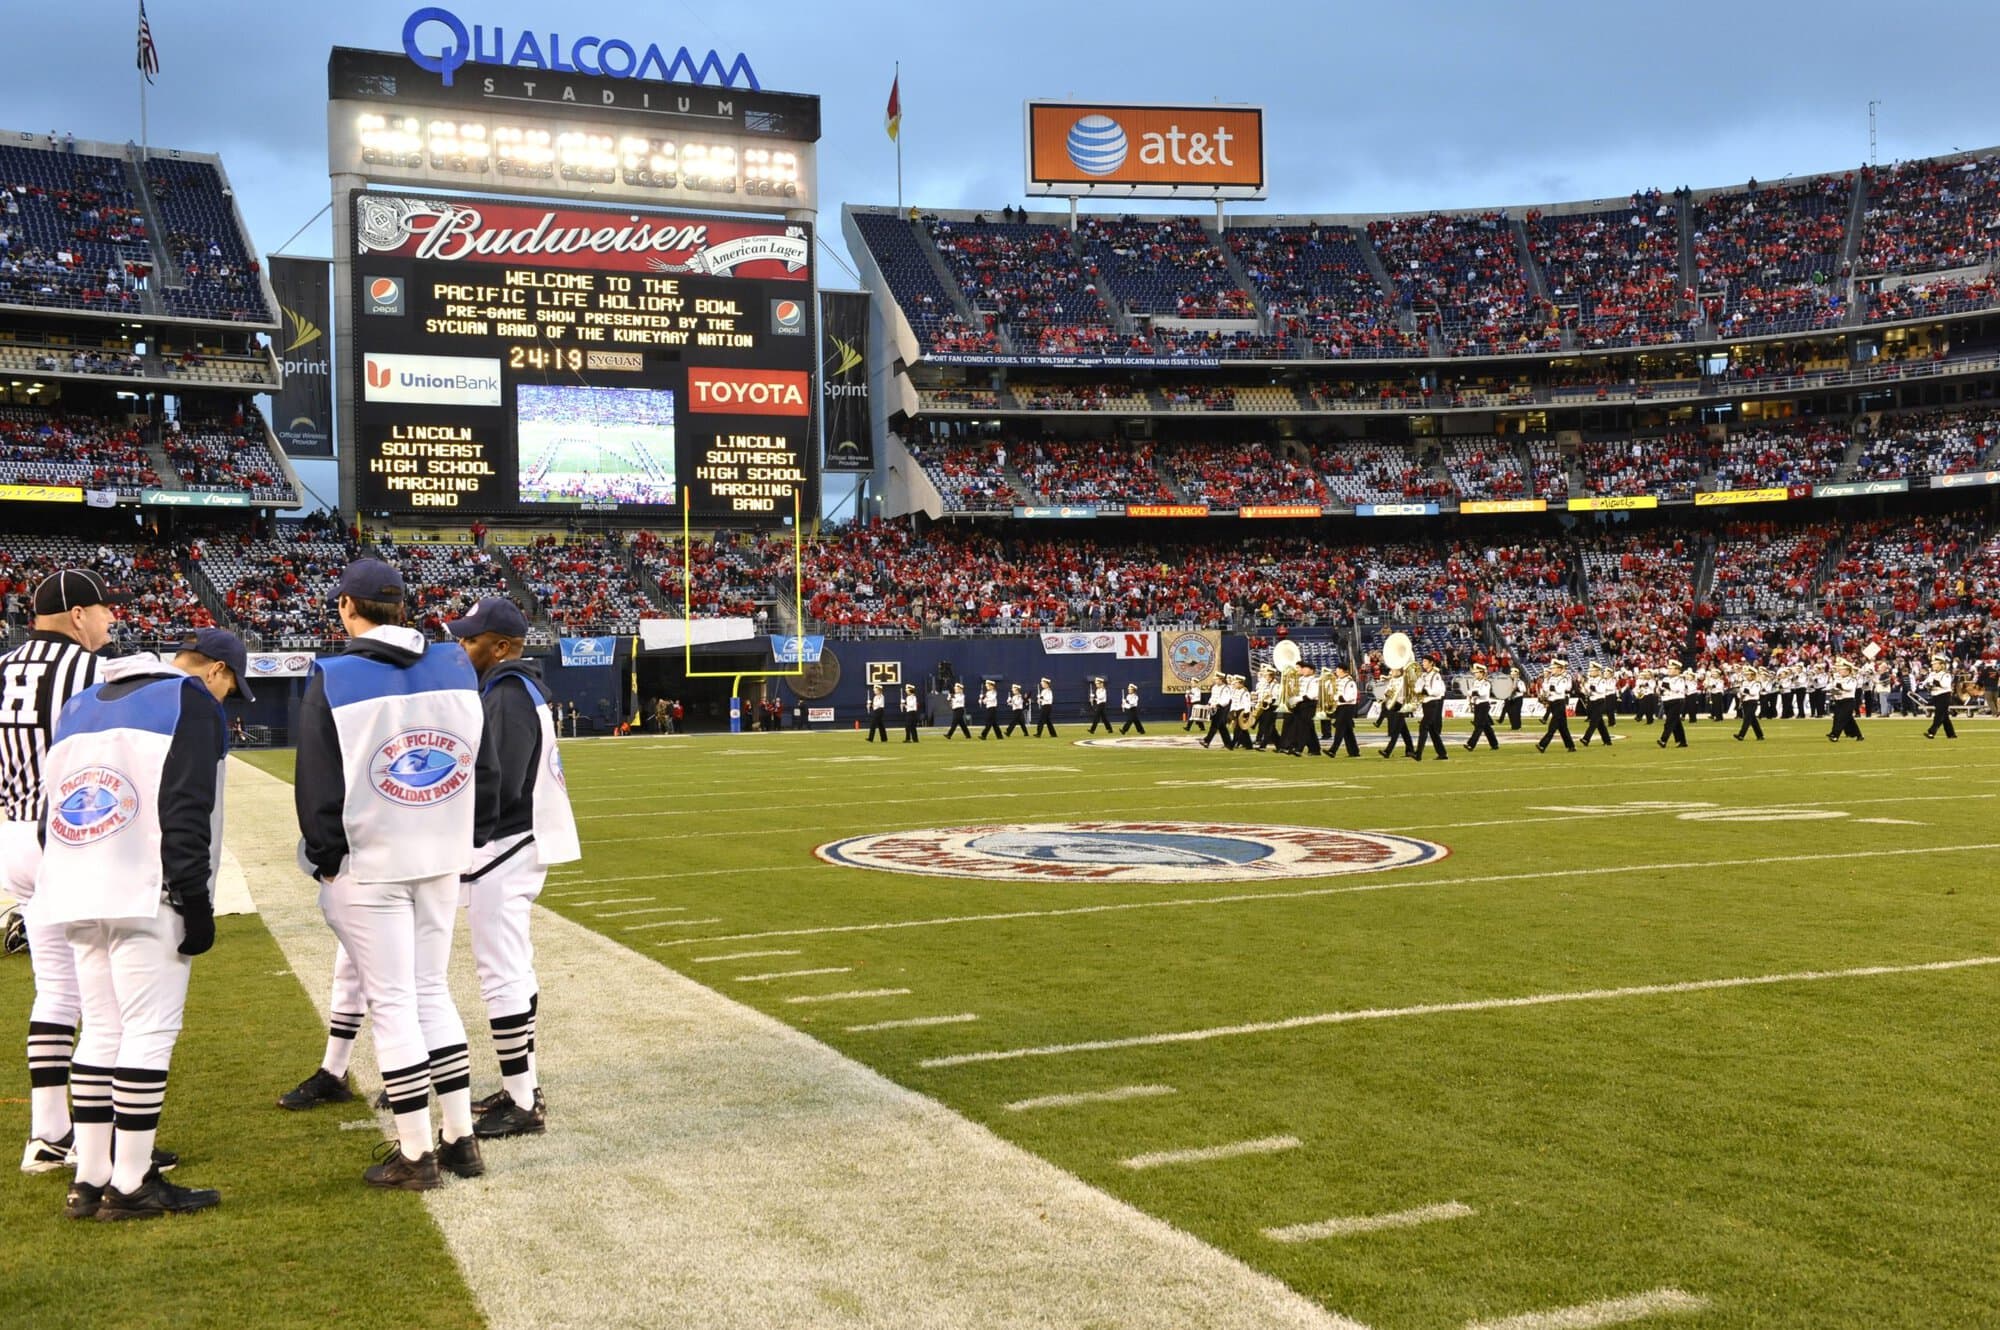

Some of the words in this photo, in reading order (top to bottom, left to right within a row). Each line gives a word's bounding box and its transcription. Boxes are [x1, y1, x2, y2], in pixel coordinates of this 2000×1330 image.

[402, 7, 760, 91] QUALCOMM
[484, 78, 733, 116] STADIUM
[1140, 125, 1233, 166] at&t
[402, 208, 707, 261] Budweiser
[711, 246, 766, 267] American
[769, 242, 805, 258] Lager
[506, 270, 594, 290] WELCOME
[606, 276, 631, 292] TO
[642, 278, 679, 294] THE
[434, 284, 525, 304] PACIFIC
[536, 290, 587, 307] LIFE
[599, 294, 684, 312] HOLIDAY
[696, 299, 743, 316] BOWL
[372, 305, 397, 314] pepsi
[446, 305, 527, 321] PRE-GAME
[536, 310, 576, 323] SHOW
[584, 313, 670, 328] PRESENTED
[679, 317, 697, 330] BY
[706, 319, 734, 331] THE
[426, 319, 488, 335] SYCUAN
[497, 323, 537, 338] BAND
[547, 326, 565, 339] OF
[576, 328, 604, 341] THE
[614, 329, 689, 345] KUMEYAAY
[698, 333, 753, 348] NATION
[778, 326, 800, 335] pepsi
[510, 347, 582, 371] 24:19
[588, 354, 642, 367] SYCUAN
[400, 373, 498, 391] UnionBank
[824, 381, 868, 399] Sprint
[695, 381, 803, 405] TOYOTA
[393, 425, 472, 441] LINCOLN
[716, 435, 786, 449] LINCOLN
[382, 442, 483, 458] SOUTHEAST
[706, 451, 796, 465] SOUTHEAST
[371, 459, 417, 473] HIGH
[428, 460, 495, 475] SCHOOL
[697, 467, 738, 480] HIGH
[747, 468, 807, 481] SCHOOL
[387, 476, 479, 491] MARCHING
[711, 483, 792, 497] MARCHING
[412, 493, 458, 507] BAND
[733, 498, 774, 511] BAND
[1129, 506, 1167, 515] WELLS
[1169, 506, 1207, 515] FARGO
[1125, 634, 1149, 656] N
[872, 664, 896, 683] 25
[3, 663, 47, 724] H
[428, 732, 456, 751] LIFE
[379, 778, 431, 802] HOLIDAY
[433, 771, 467, 798] BOWL
